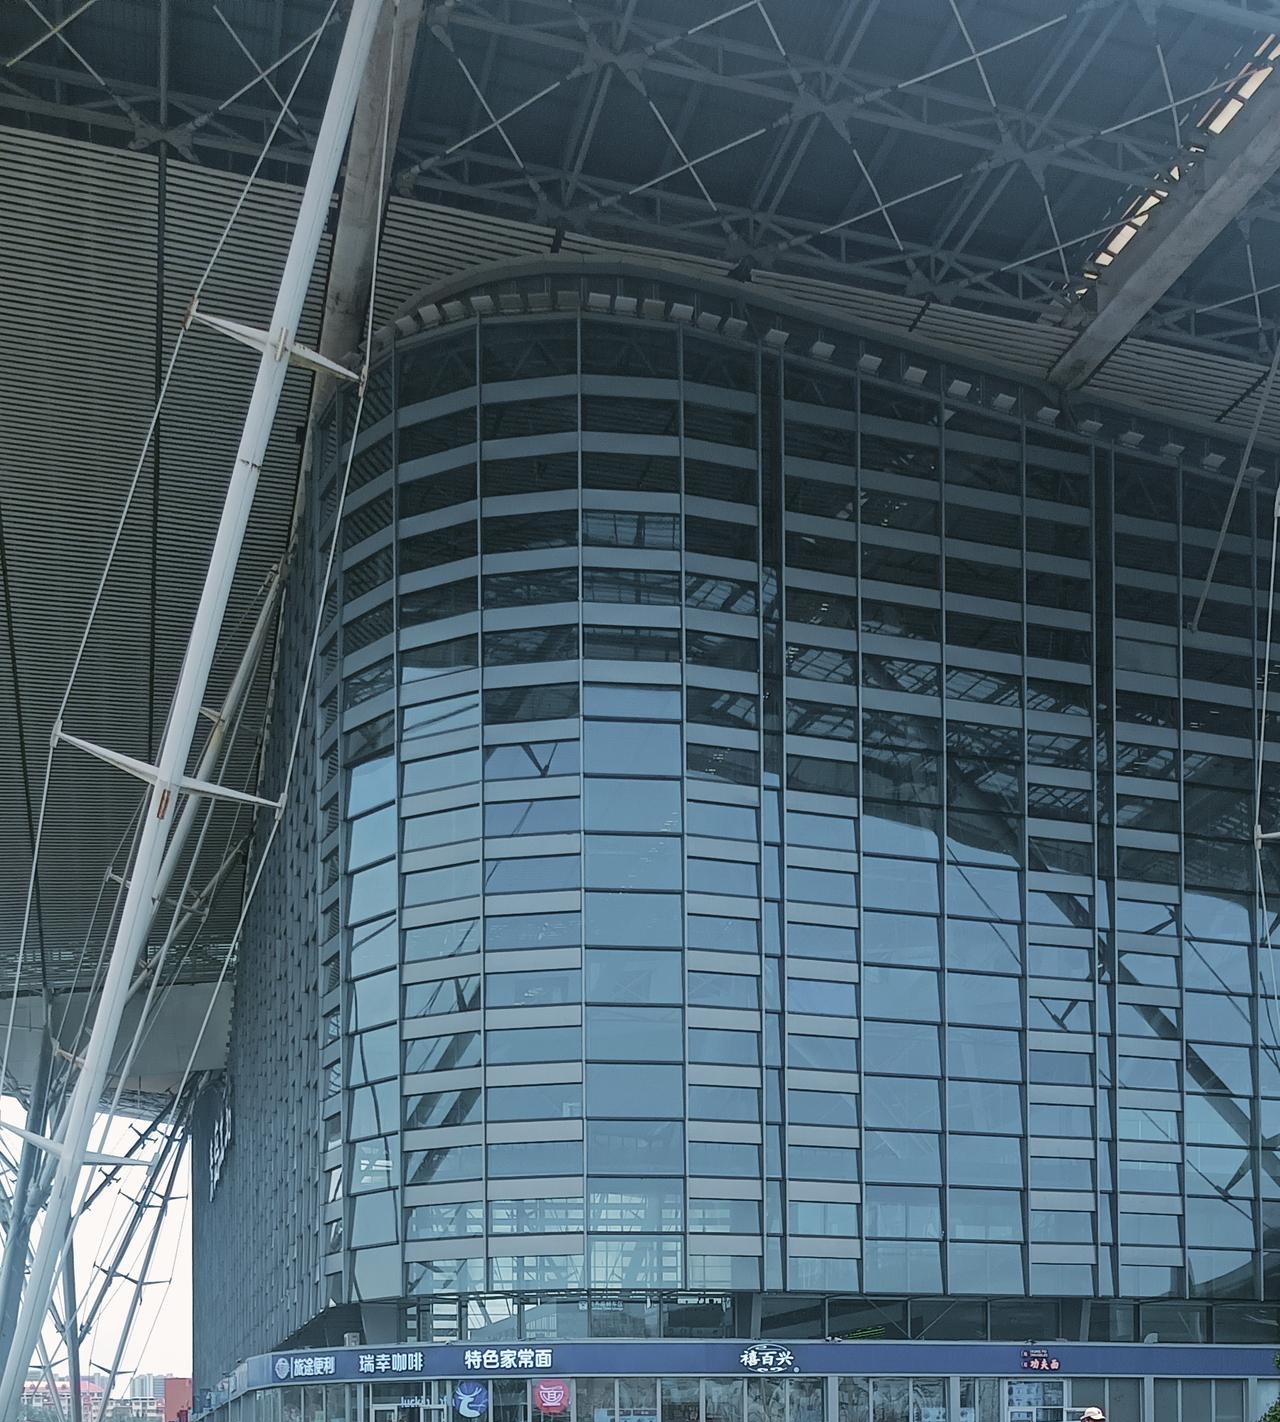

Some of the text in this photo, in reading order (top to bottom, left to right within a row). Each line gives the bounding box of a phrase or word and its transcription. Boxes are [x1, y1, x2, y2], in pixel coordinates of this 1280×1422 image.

[294, 1356, 336, 1376] 旅途便利
[359, 1352, 425, 1373] 瑞幸咖啡
[464, 1348, 552, 1369] 特色家常面
[740, 1350, 794, 1366] 禧百兴
[1030, 1358, 1059, 1370] 功夫面
